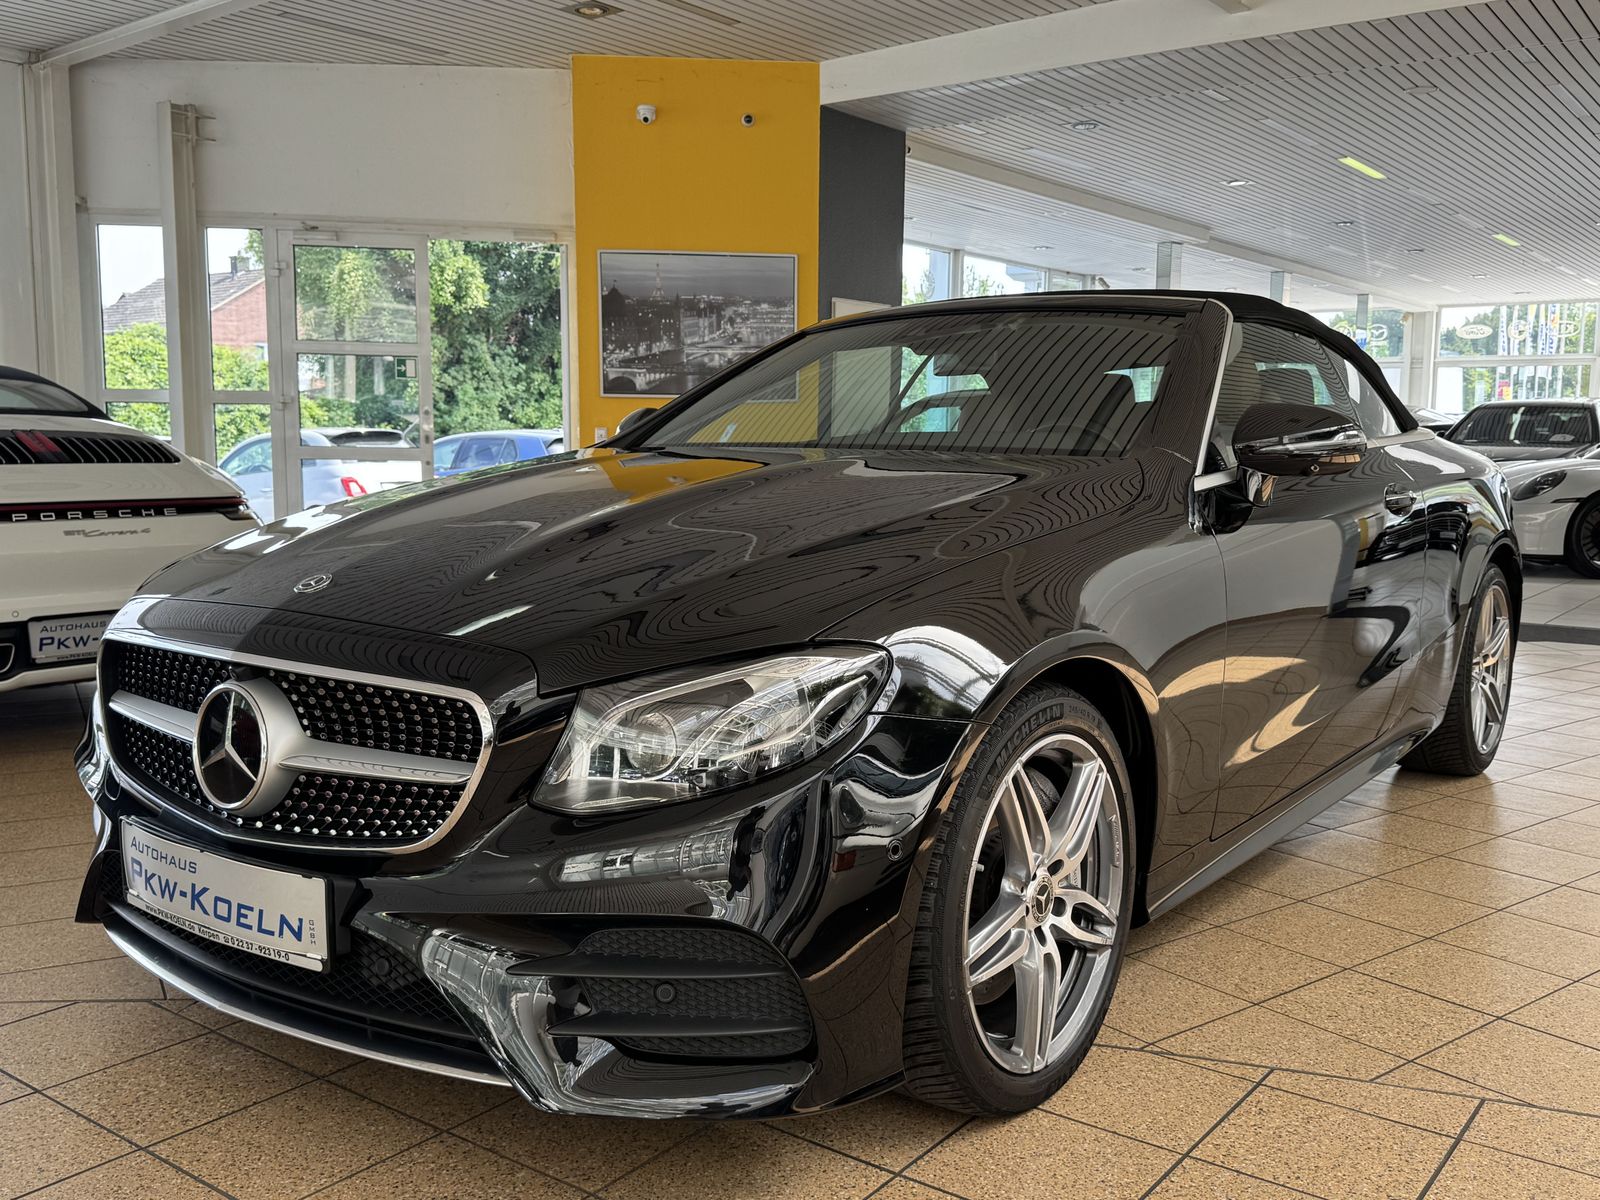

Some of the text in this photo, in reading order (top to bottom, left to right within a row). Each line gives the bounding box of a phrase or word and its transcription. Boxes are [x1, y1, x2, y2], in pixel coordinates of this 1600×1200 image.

[12, 507, 177, 522] PORSCHE
[40, 620, 106, 634] AUTOHAUS
[995, 703, 1063, 769] MICHELIN
[130, 836, 197, 874] AUTOHAUS
[130, 857, 304, 942] PKW-KOELN
[198, 926, 221, 941] Kerpen
